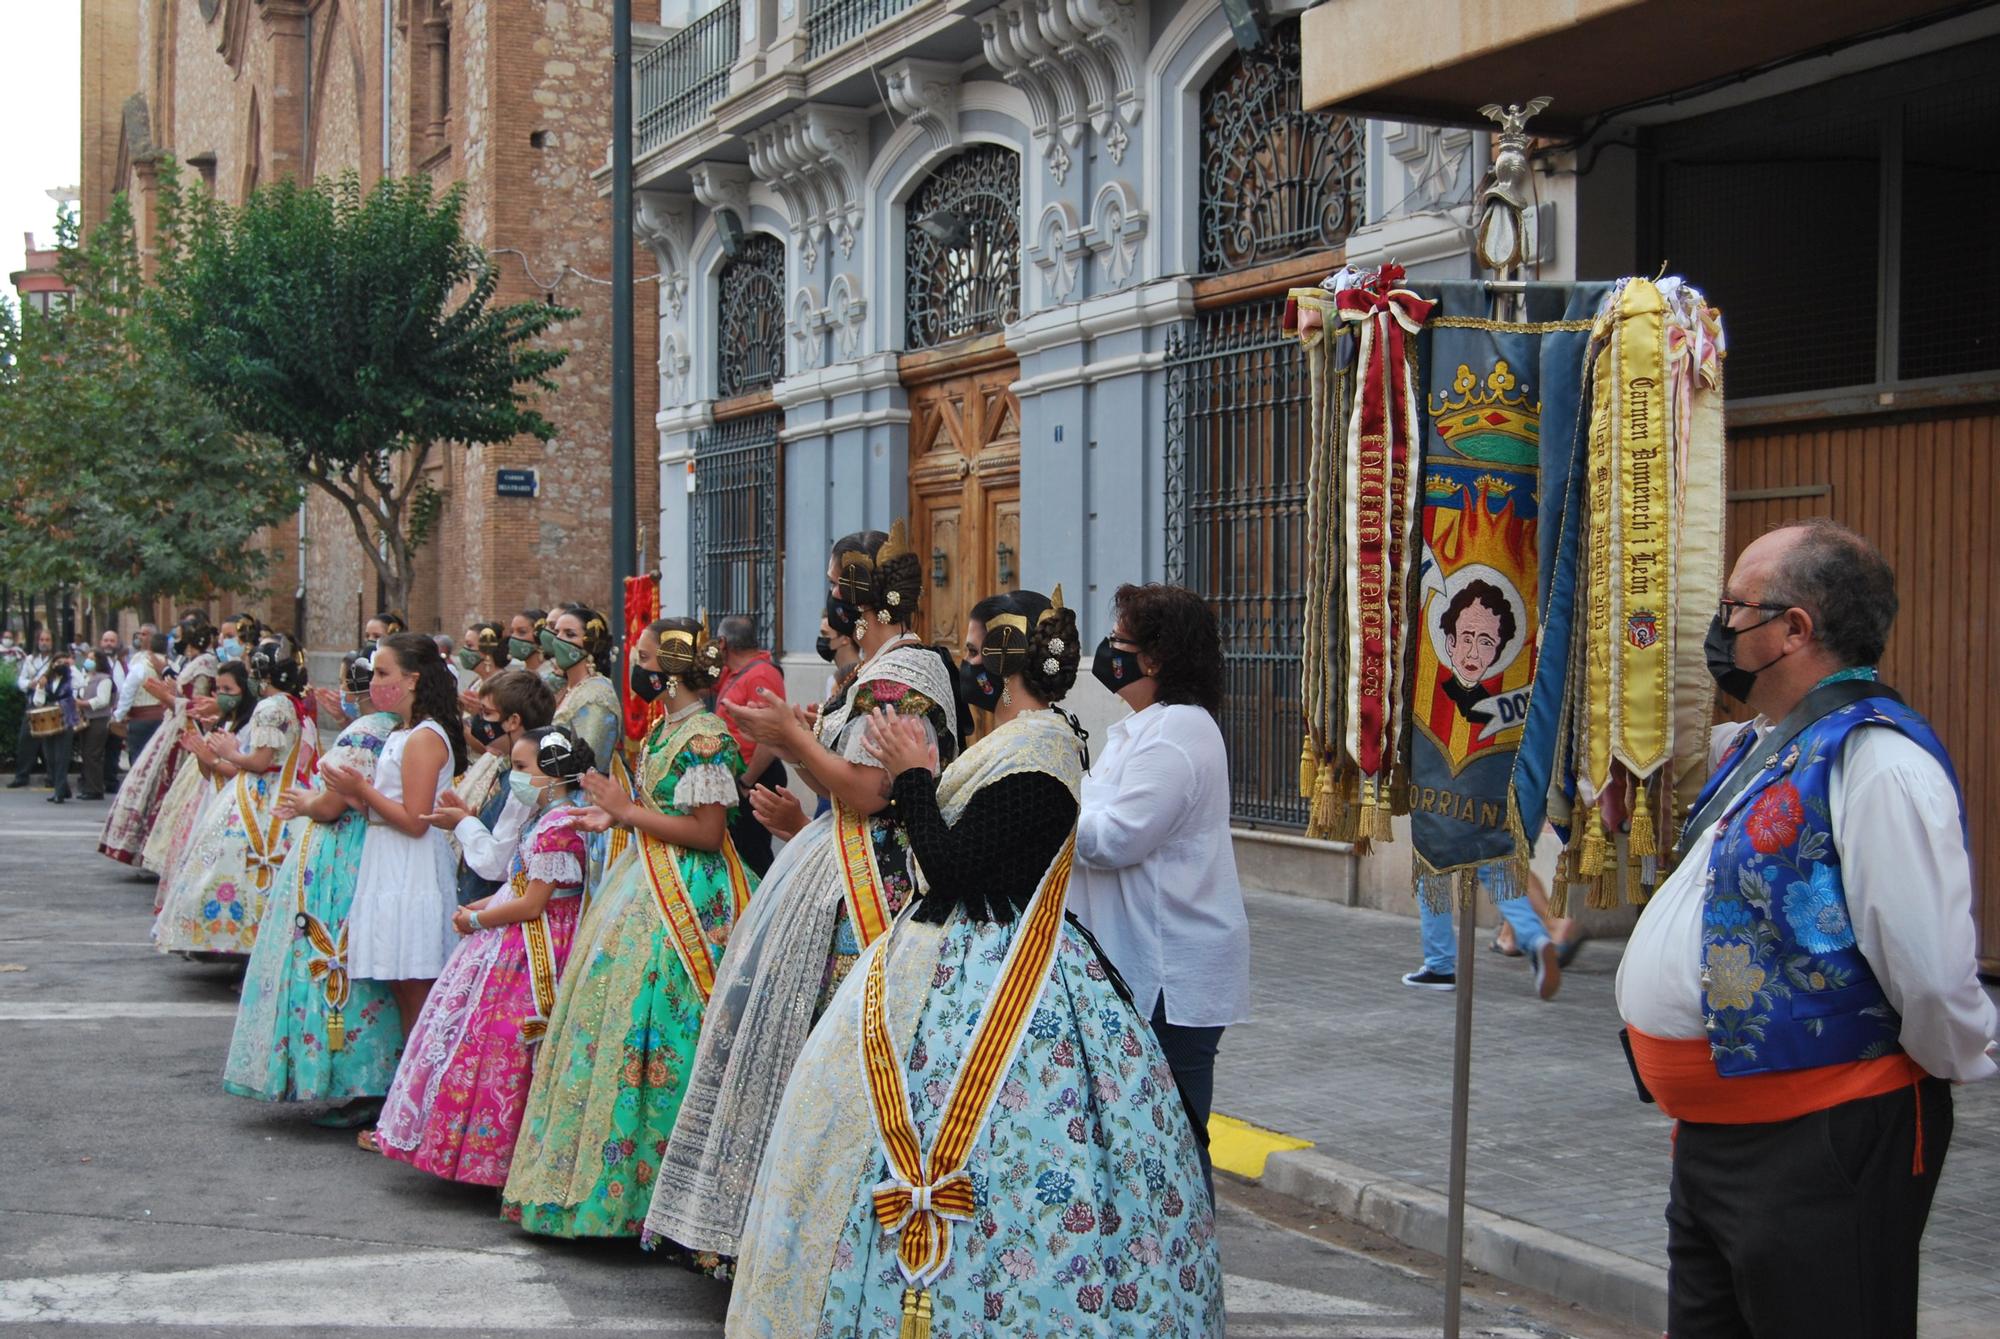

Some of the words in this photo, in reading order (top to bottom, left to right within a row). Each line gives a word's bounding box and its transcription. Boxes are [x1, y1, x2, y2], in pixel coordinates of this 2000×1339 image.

[1629, 377, 1655, 440] Carmen
[1360, 434, 1383, 542] FALLERA
[1631, 448, 1658, 531] Doménech
[1360, 564, 1381, 641] MAJOR
[1630, 552, 1657, 595] León
[1595, 596, 1605, 630] 2013
[1497, 691, 1532, 724] DO
